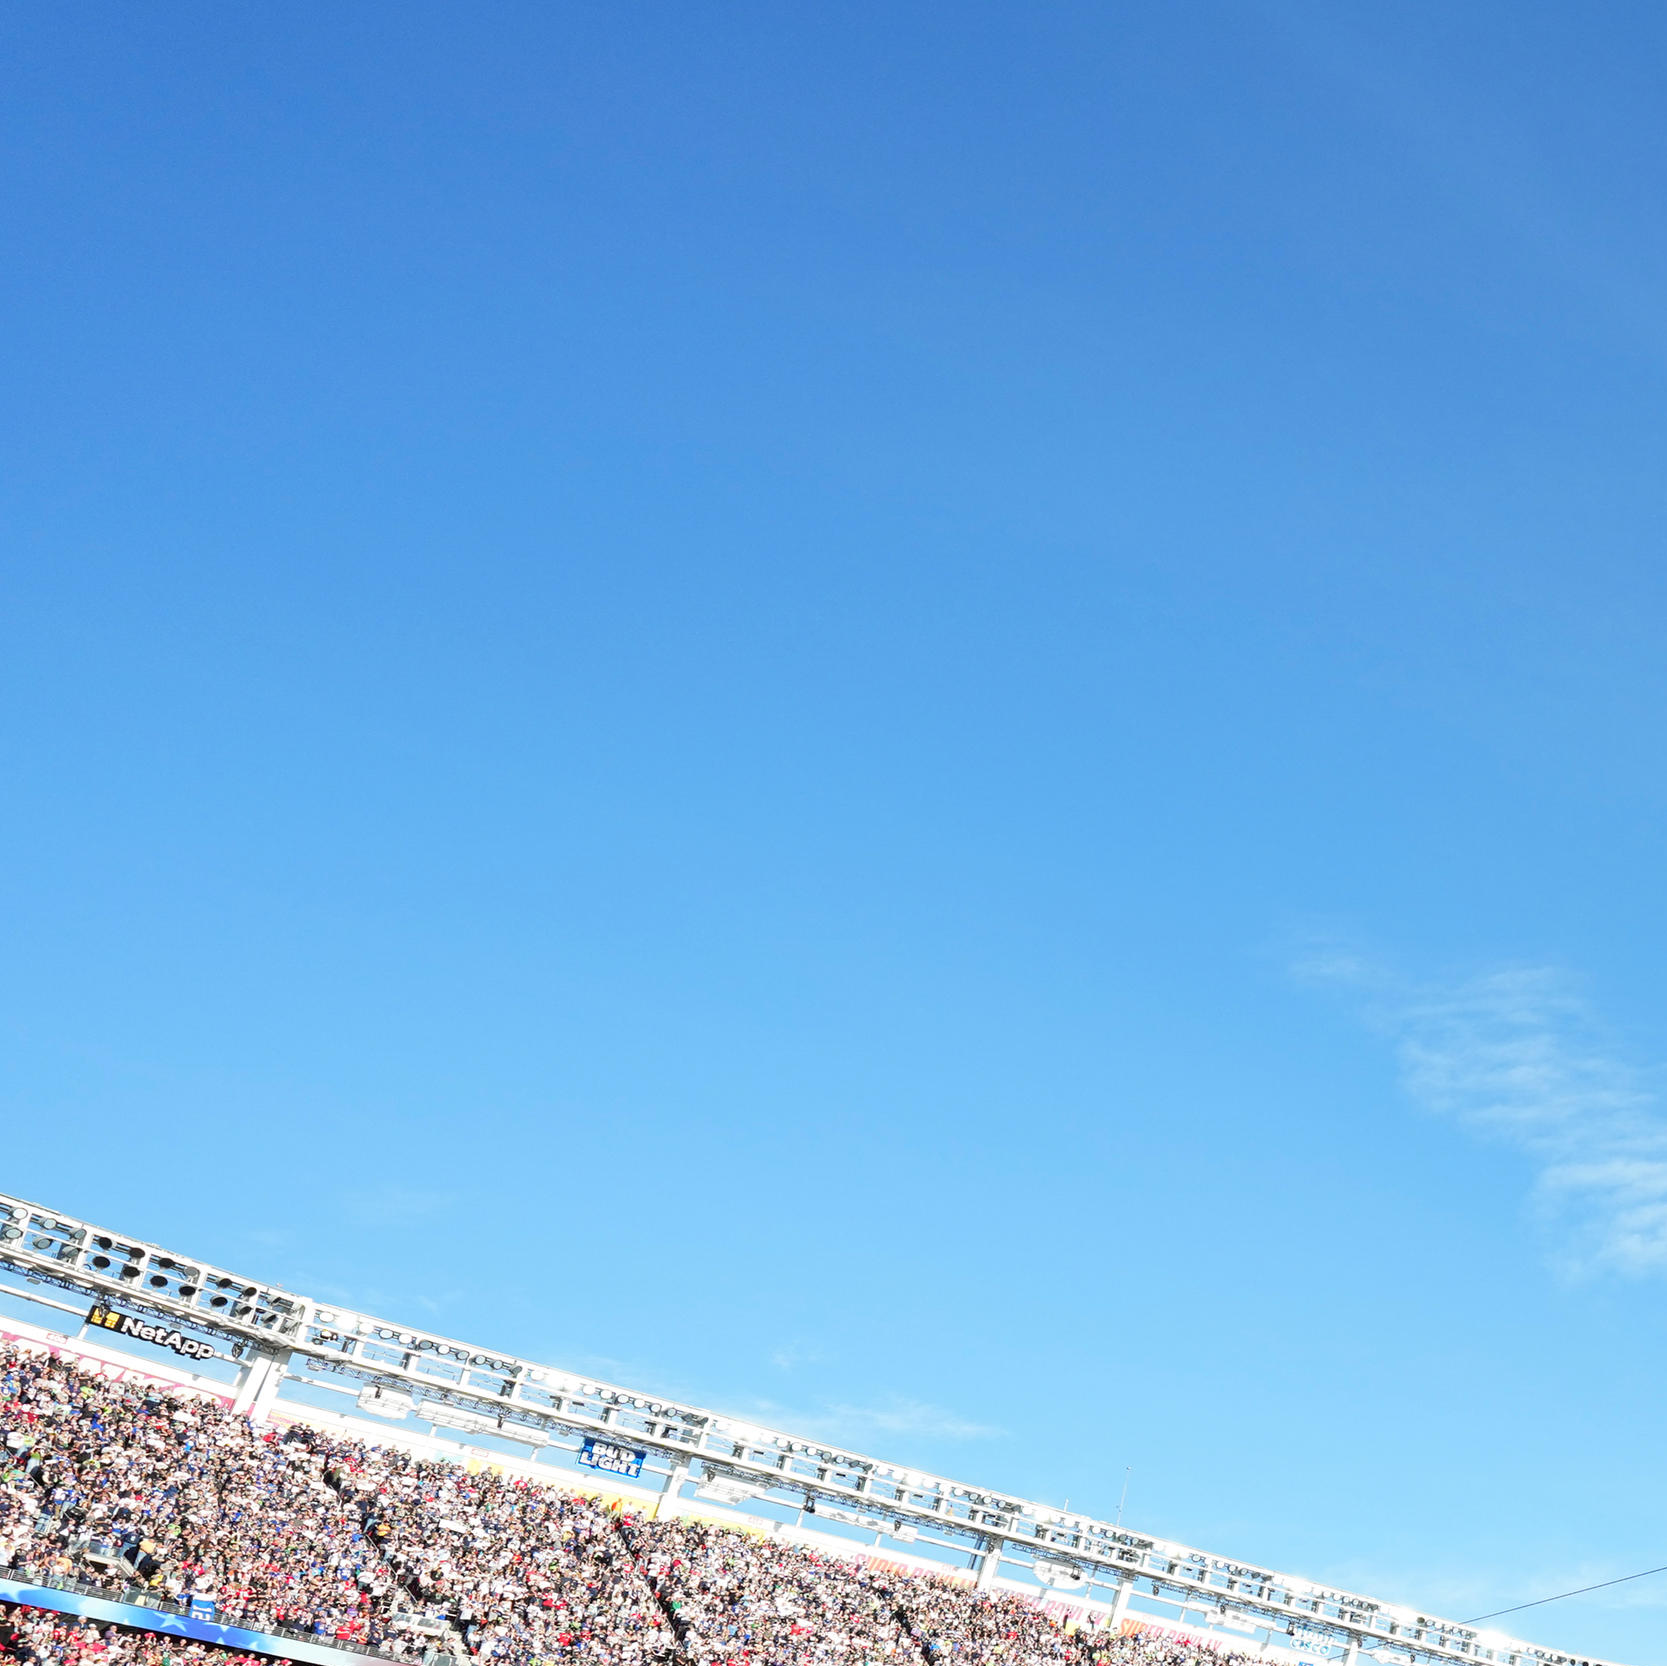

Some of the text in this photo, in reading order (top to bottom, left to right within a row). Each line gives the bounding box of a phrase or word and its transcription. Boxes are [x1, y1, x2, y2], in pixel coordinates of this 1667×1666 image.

[121, 1316, 216, 1360] NetApp
[592, 1442, 637, 1461] BUD
[580, 1452, 640, 1476] LIGHT
